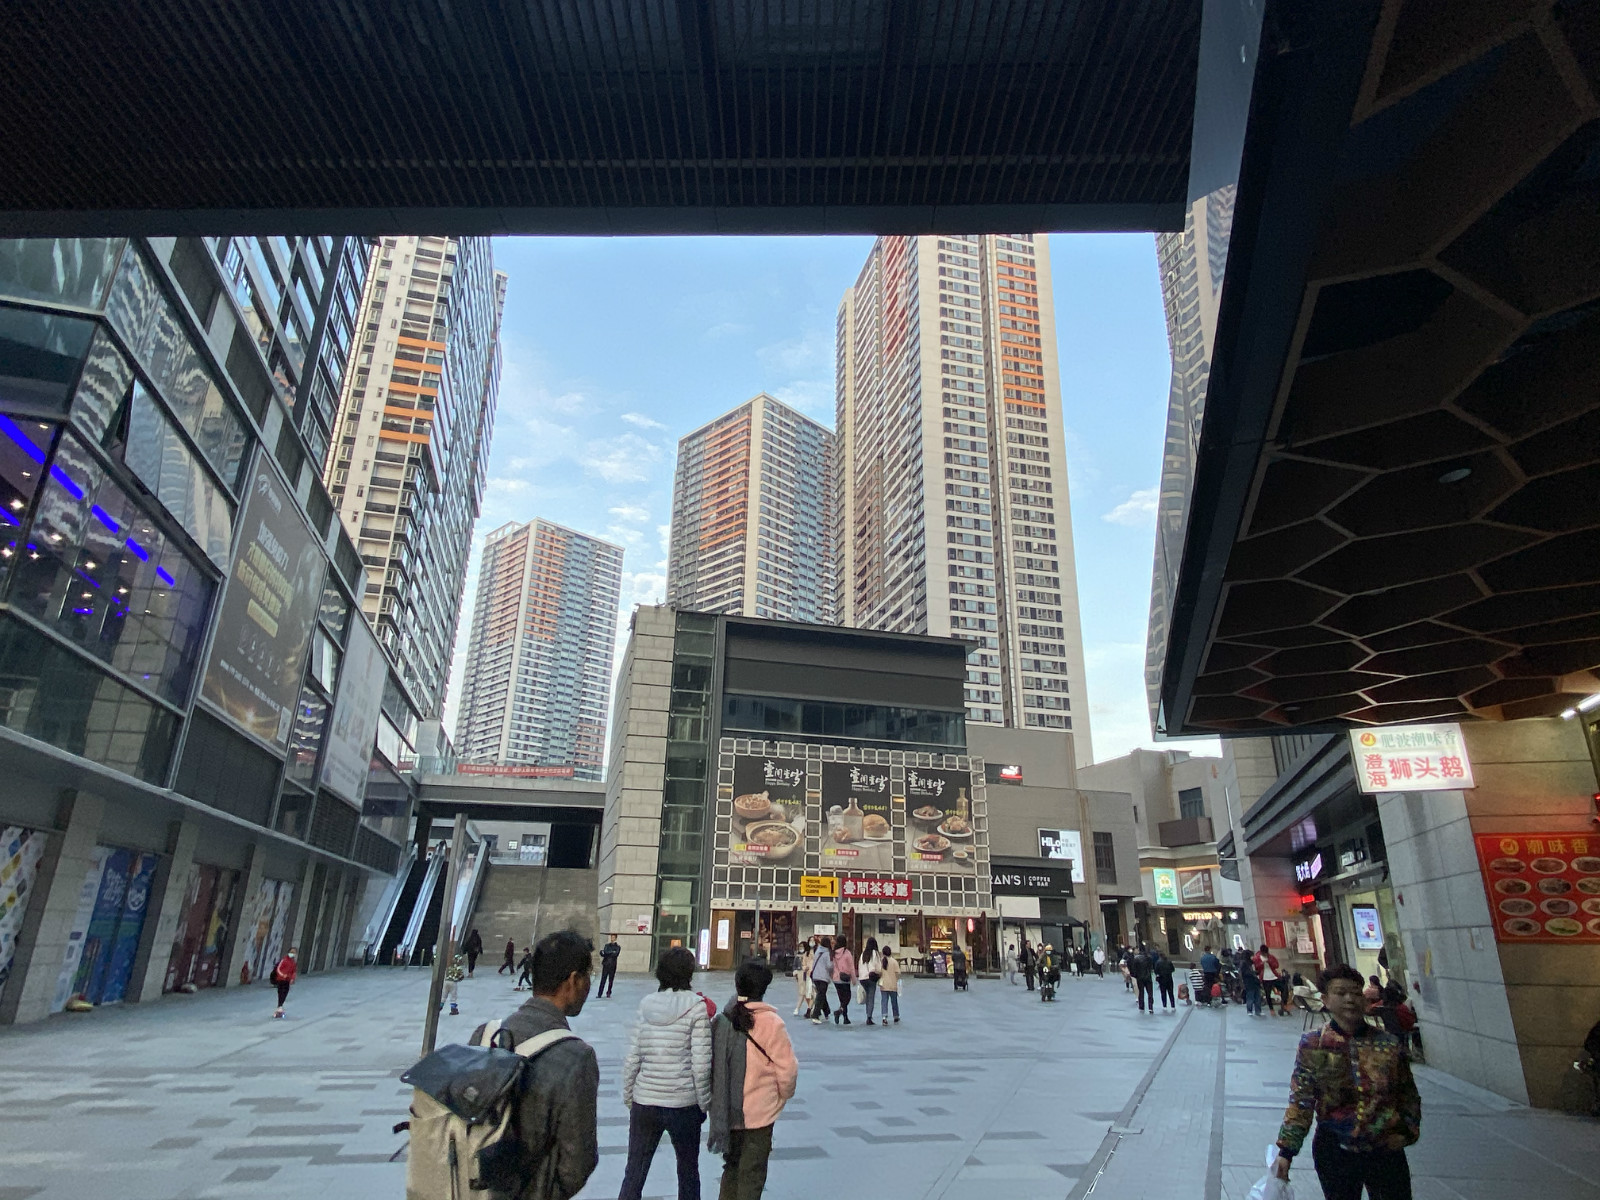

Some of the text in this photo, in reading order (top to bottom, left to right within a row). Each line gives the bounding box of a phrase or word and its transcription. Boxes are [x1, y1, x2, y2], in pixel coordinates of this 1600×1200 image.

[1381, 730, 1456, 748] 肥波潮味香
[1364, 754, 1388, 787] 澄海
[1388, 755, 1464, 780] 狮头鹅
[843, 879, 909, 897] 壹間茶餐廳
